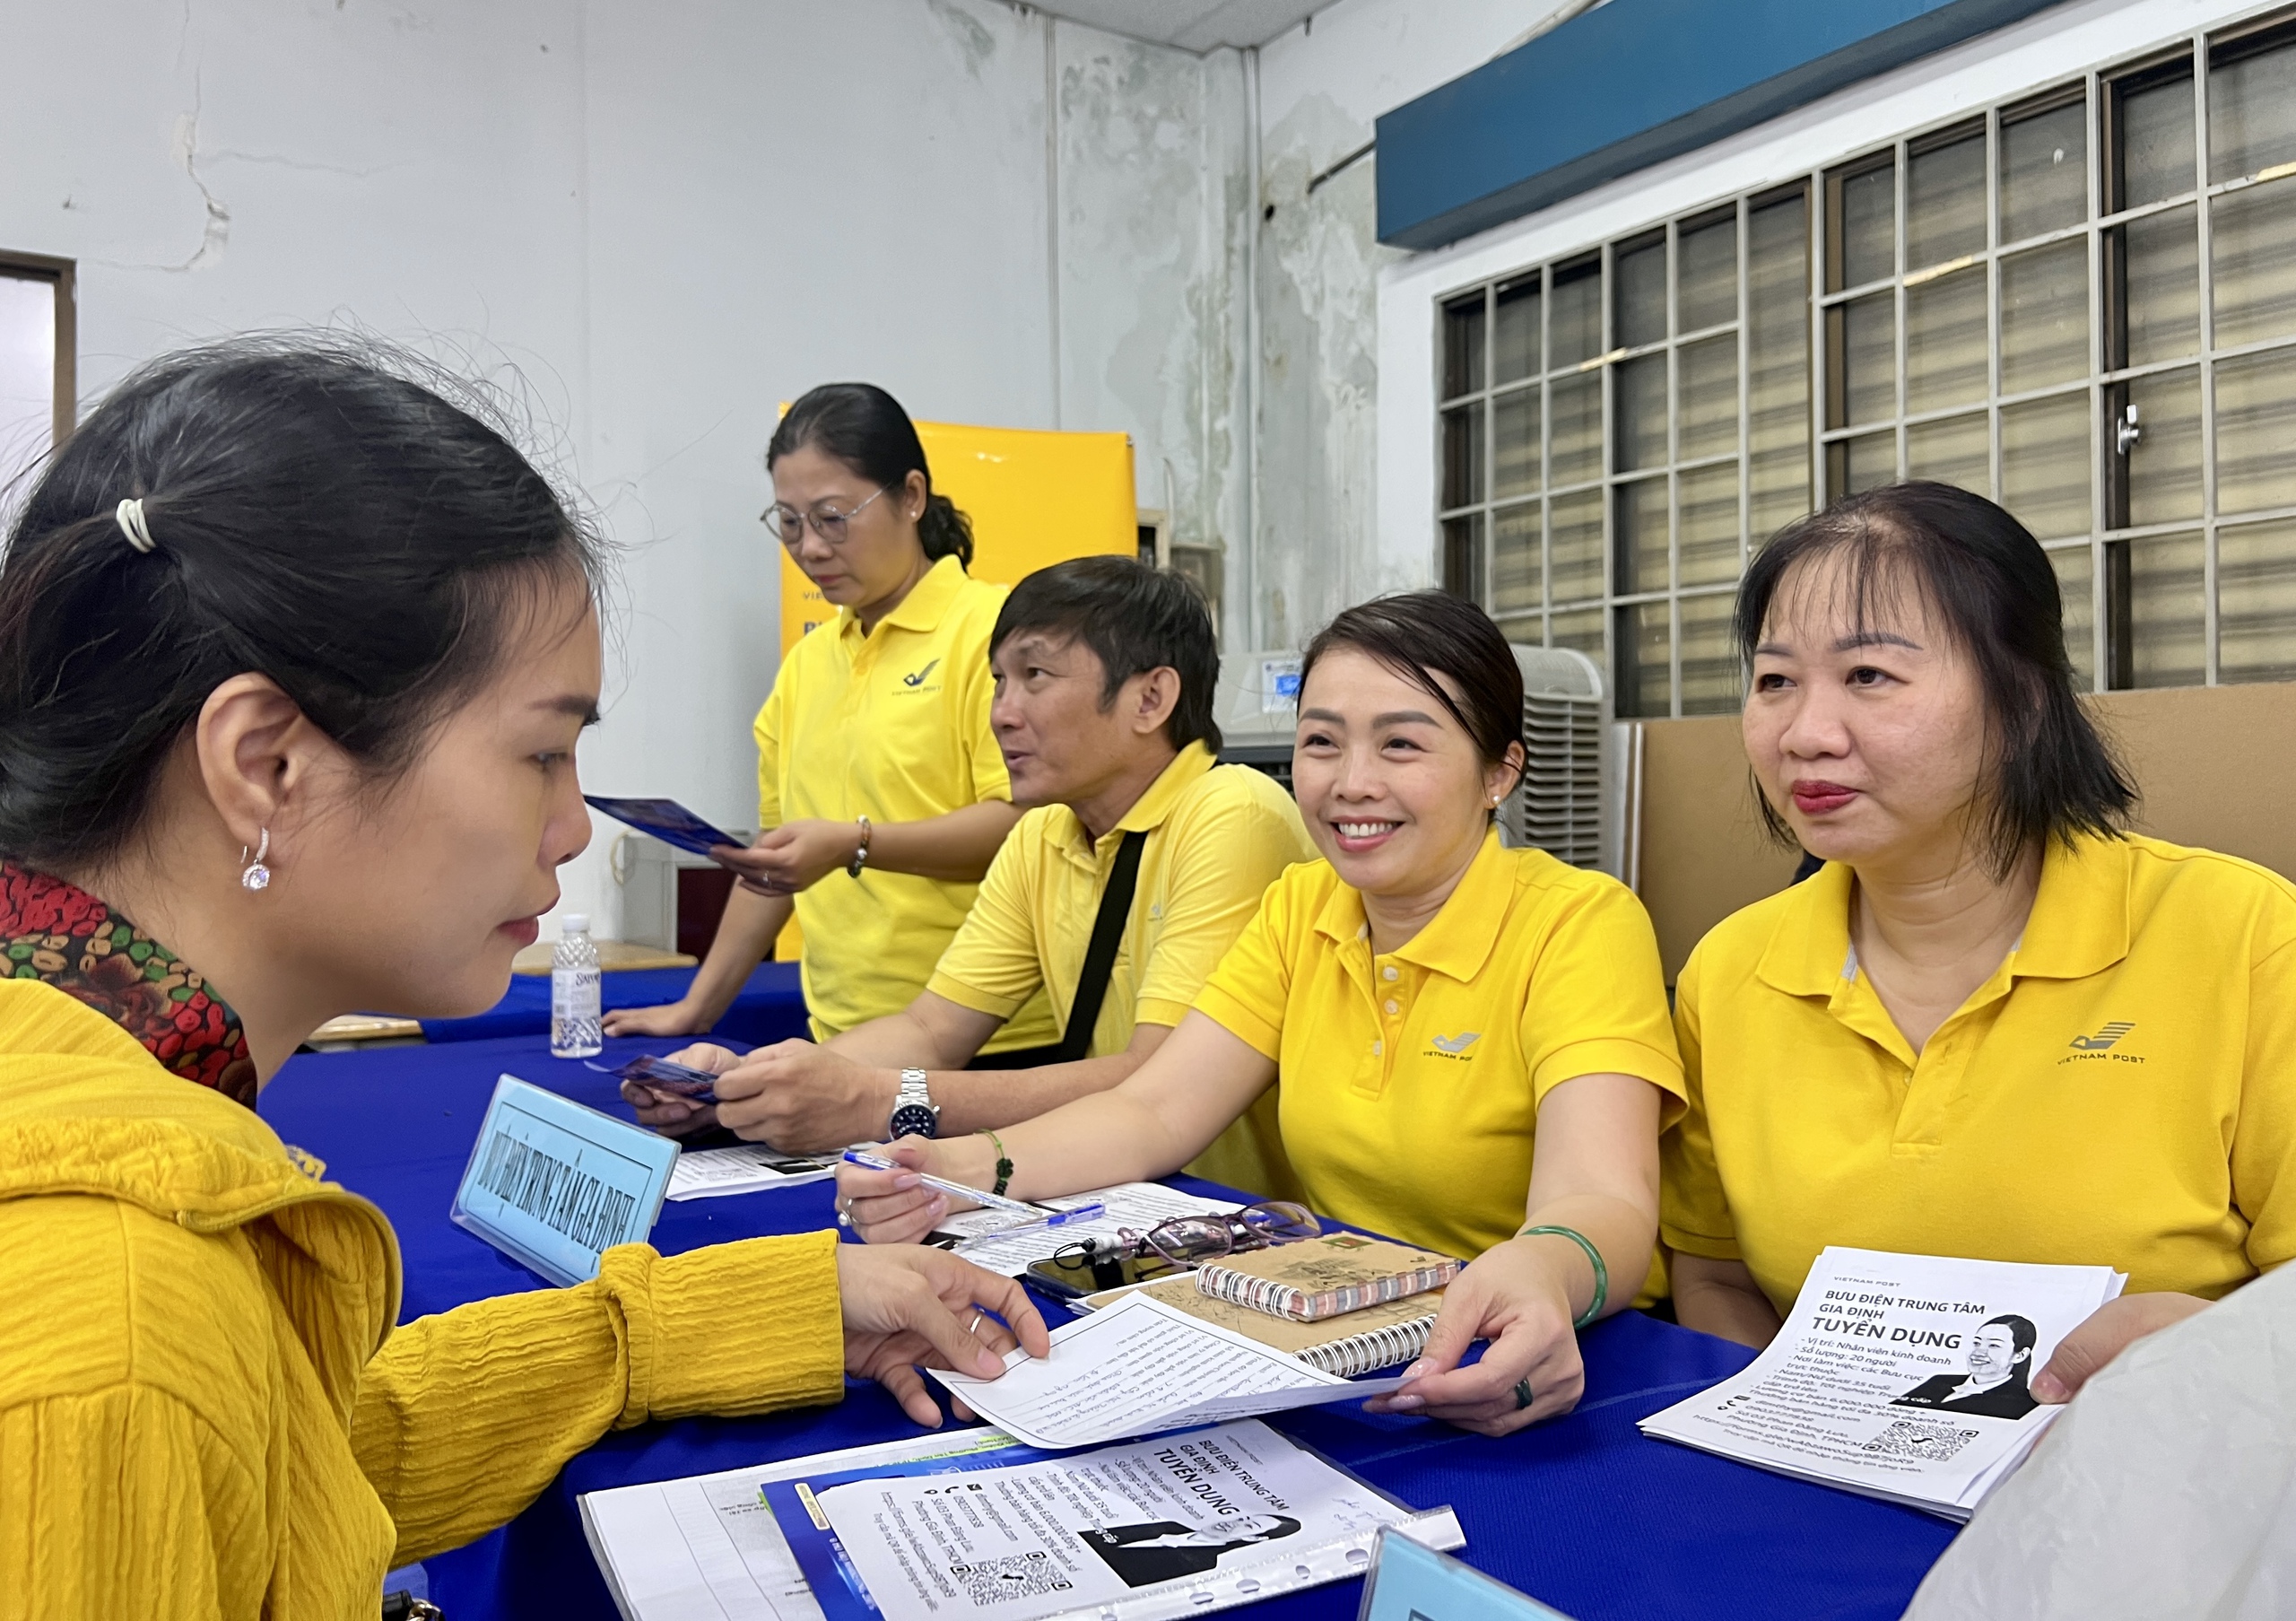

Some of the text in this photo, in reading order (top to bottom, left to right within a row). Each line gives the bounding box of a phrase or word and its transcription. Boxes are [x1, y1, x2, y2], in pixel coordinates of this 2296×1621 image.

[2057, 1053, 2146, 1065] VIETNAM POST
[1819, 1303, 1884, 1320] GIA ĐỊNH
[1825, 1290, 1985, 1314] BƯU ĐIỆN TRUNG TÂM
[1813, 1317, 1962, 1349] TUYỂN DỤNG
[1808, 1337, 1952, 1365] Vị trí: Nhân viên kinh doanh
[1179, 1444, 1199, 1457] GIA
[1193, 1456, 1221, 1475] ĐỊNH
[1198, 1440, 1223, 1454] BƯU
[1214, 1454, 1242, 1471] ĐIỆN
[1234, 1470, 1270, 1495] TRUNG
[1264, 1495, 1290, 1511] TÂM
[1190, 1483, 1240, 1515] DỤNG
